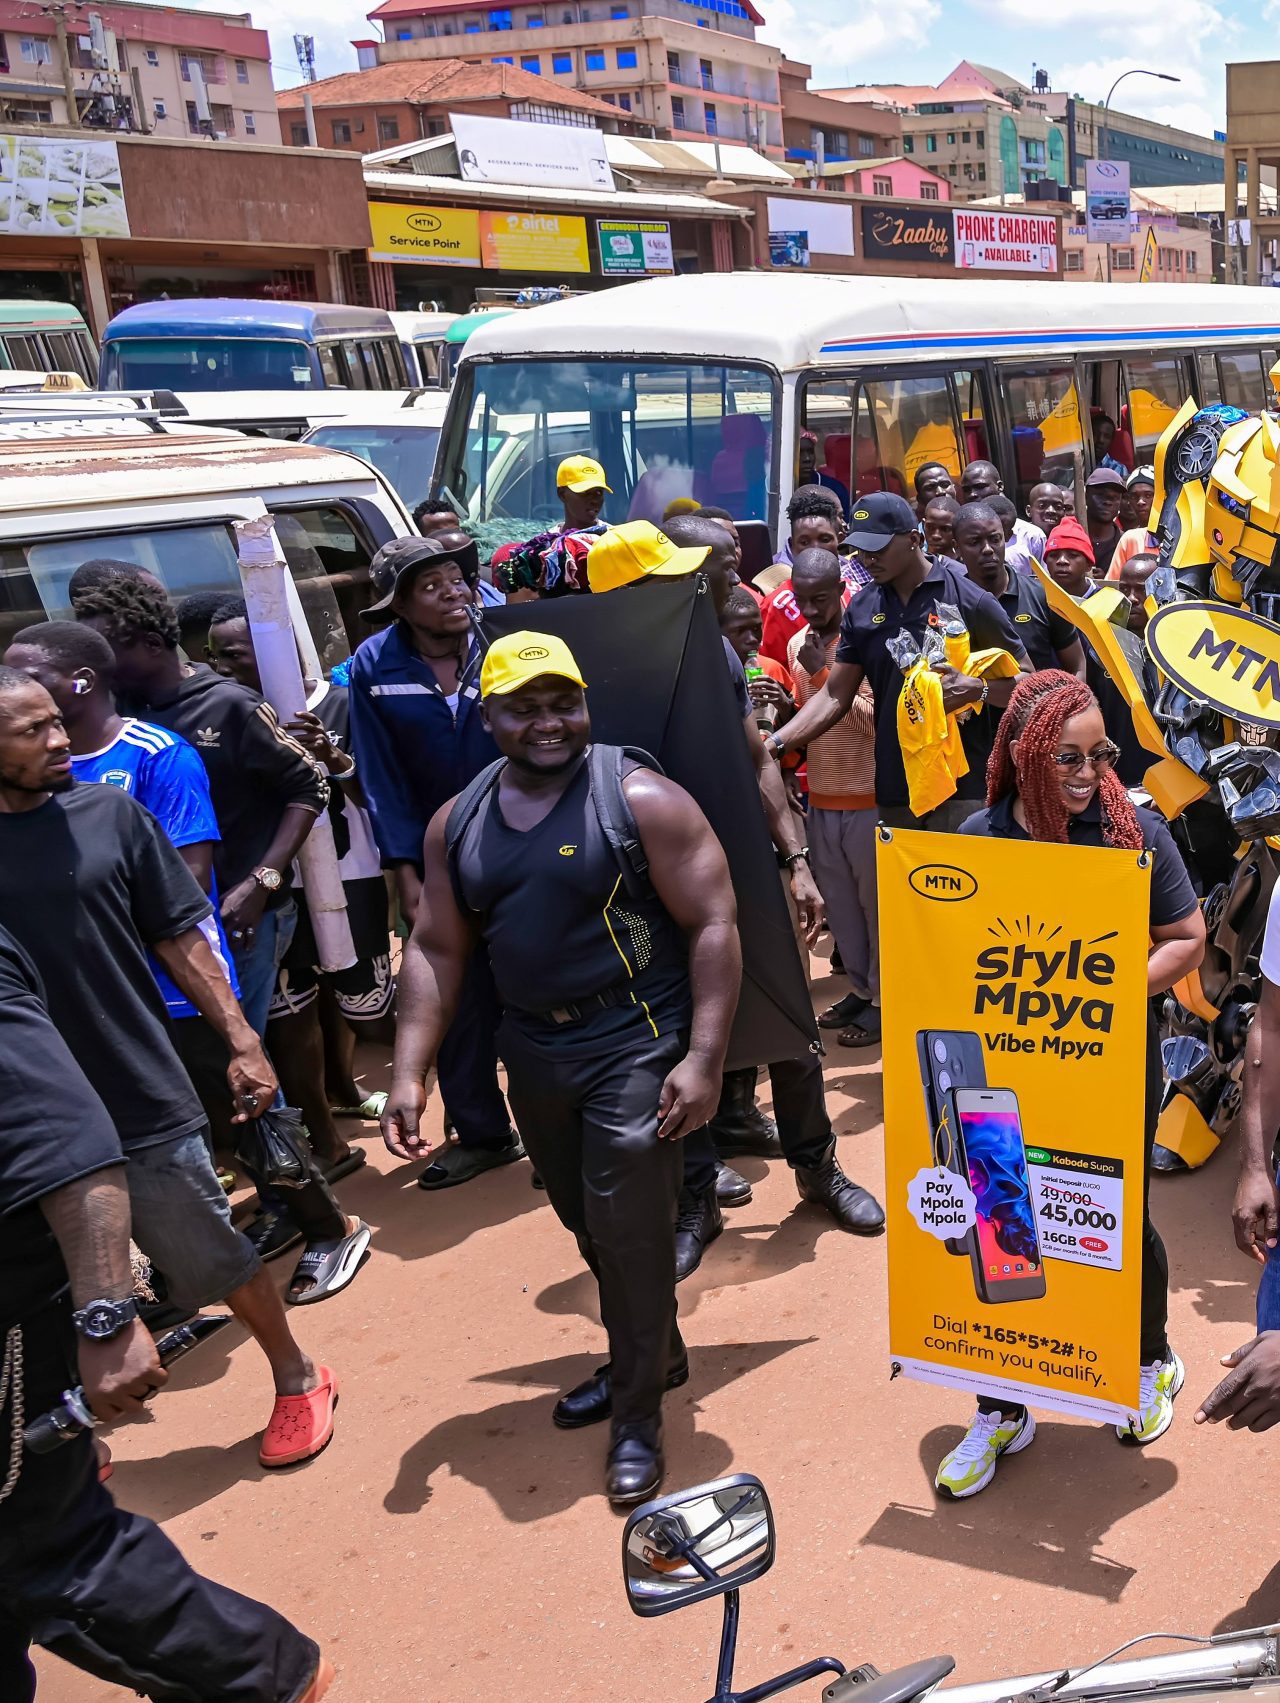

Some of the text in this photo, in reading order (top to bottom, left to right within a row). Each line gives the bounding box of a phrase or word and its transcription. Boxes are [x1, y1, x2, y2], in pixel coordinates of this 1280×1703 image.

[414, 218, 434, 228] MTN
[521, 214, 560, 233] airtel
[956, 215, 1057, 245] PHONE CHARGING
[389, 235, 461, 249] Service Point
[984, 247, 1032, 263] AVAILABLE
[47, 374, 69, 387] TAXI
[524, 649, 544, 657] MTN
[195, 740, 221, 748] adidas
[925, 874, 962, 891] MTN
[973, 982, 1115, 1034] Mpya
[984, 1032, 1104, 1061] Vibe Mpya
[1028, 1150, 1115, 1173] NEW Kabode Supa
[925, 1180, 953, 1198] Pay
[1041, 1175, 1058, 1183] Initial
[1058, 1178, 1082, 1188] Deposit
[920, 1195, 965, 1211] Mpola
[1040, 1186, 1092, 1207] 49,000
[923, 1210, 967, 1226] Mpola
[1040, 1202, 1117, 1231] 45,000
[1042, 1230, 1103, 1249] 16GB FREE
[933, 1315, 967, 1335] Dial
[1077, 1344, 1098, 1363] to
[924, 1335, 995, 1361] confirm
[998, 1348, 1034, 1370] you
[1038, 1355, 1107, 1388] qualify.
